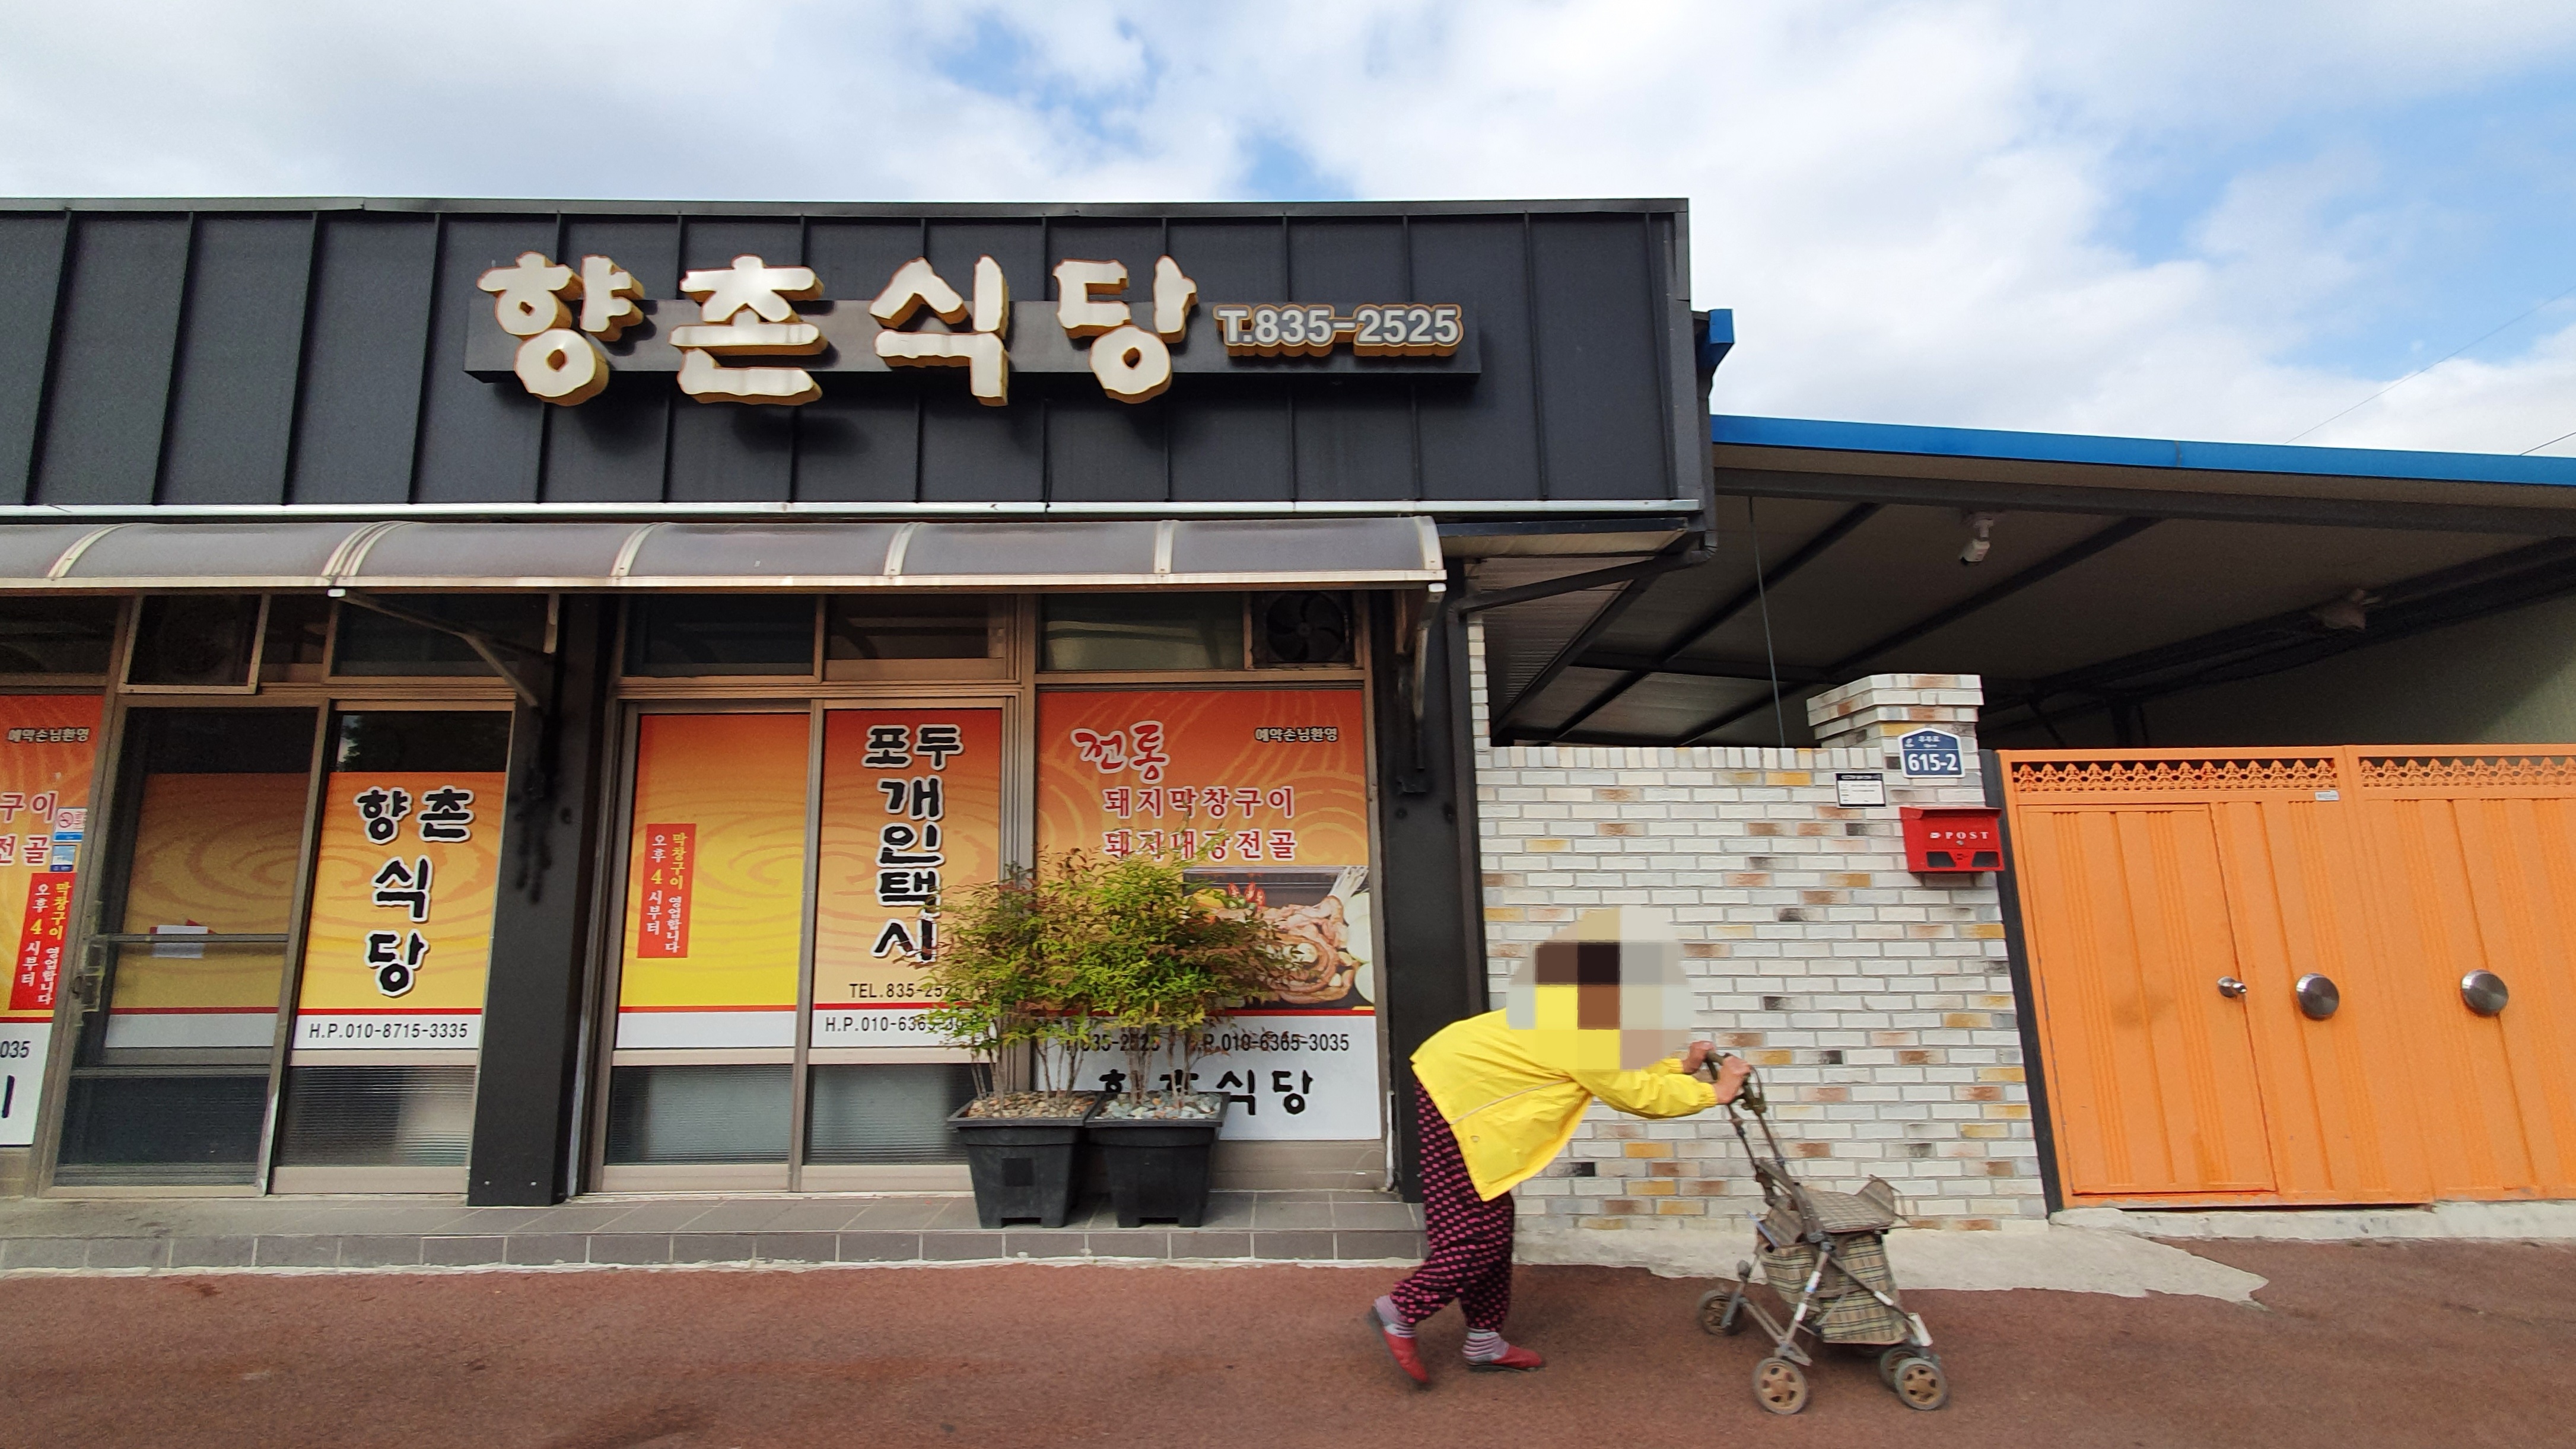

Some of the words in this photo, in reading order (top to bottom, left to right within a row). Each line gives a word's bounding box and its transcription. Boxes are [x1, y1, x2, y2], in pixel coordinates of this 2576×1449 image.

[477, 251, 1197, 406] 향촌식당
[1215, 305, 1462, 352] T.835-2525
[861, 724, 964, 770] 포두
[1254, 727, 1338, 742] 예약손님환영
[1907, 753, 1958, 771] 615-2
[1102, 786, 1295, 819] 돼지막창구이
[651, 835, 667, 862] 오후
[669, 832, 688, 890] 막창구이
[32, 883, 50, 913] 오후
[49, 881, 72, 940] 막창구이
[665, 896, 682, 953] 영업합니다
[38, 947, 59, 1005] 영업합니다
[848, 983, 959, 998] TEL.835-25
[309, 1023, 468, 1039] H.P.010-8715-3335
